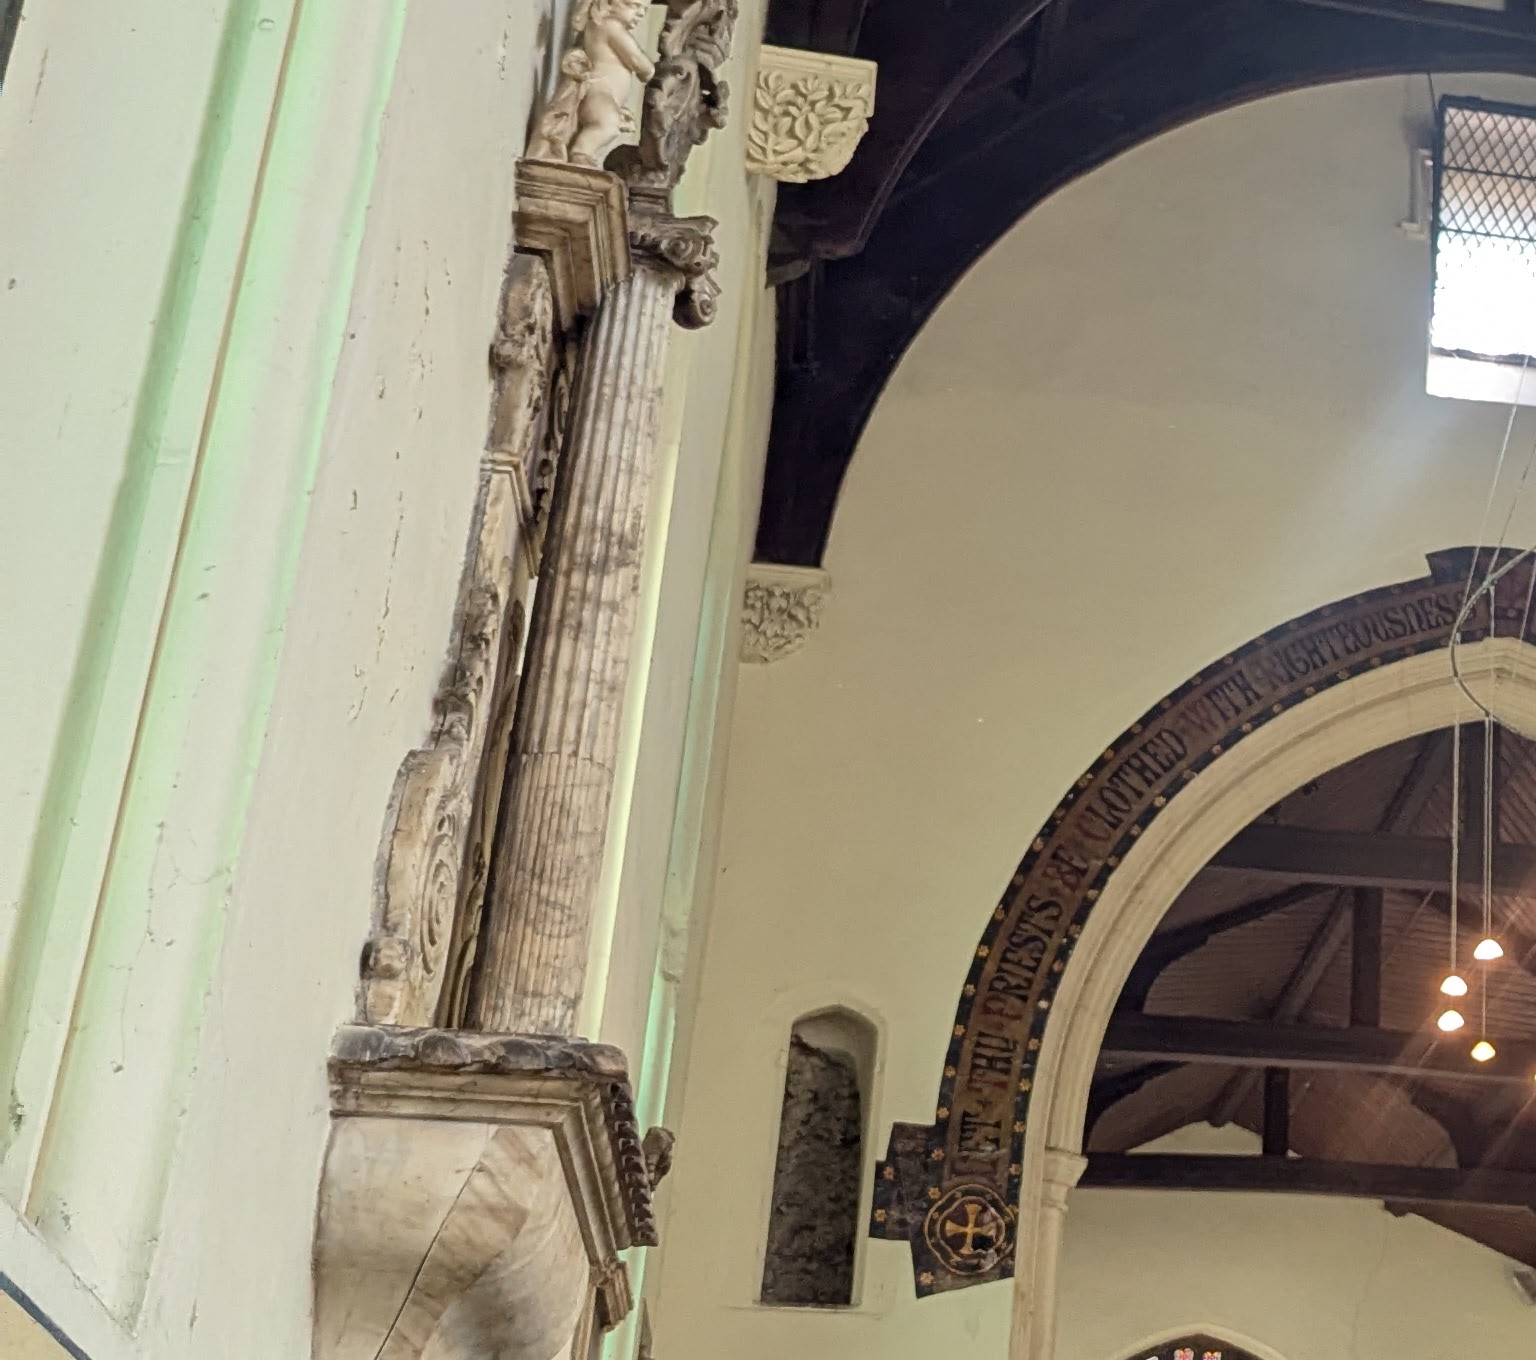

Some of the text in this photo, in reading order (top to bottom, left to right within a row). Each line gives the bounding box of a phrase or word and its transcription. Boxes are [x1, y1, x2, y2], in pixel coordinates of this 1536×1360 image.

[981, 894, 1063, 1022] PRIESTS
[1076, 728, 1188, 840] CLOTHED
[1180, 669, 1263, 734] WITH
[1257, 592, 1477, 691] RIGHTEOUSNESS
